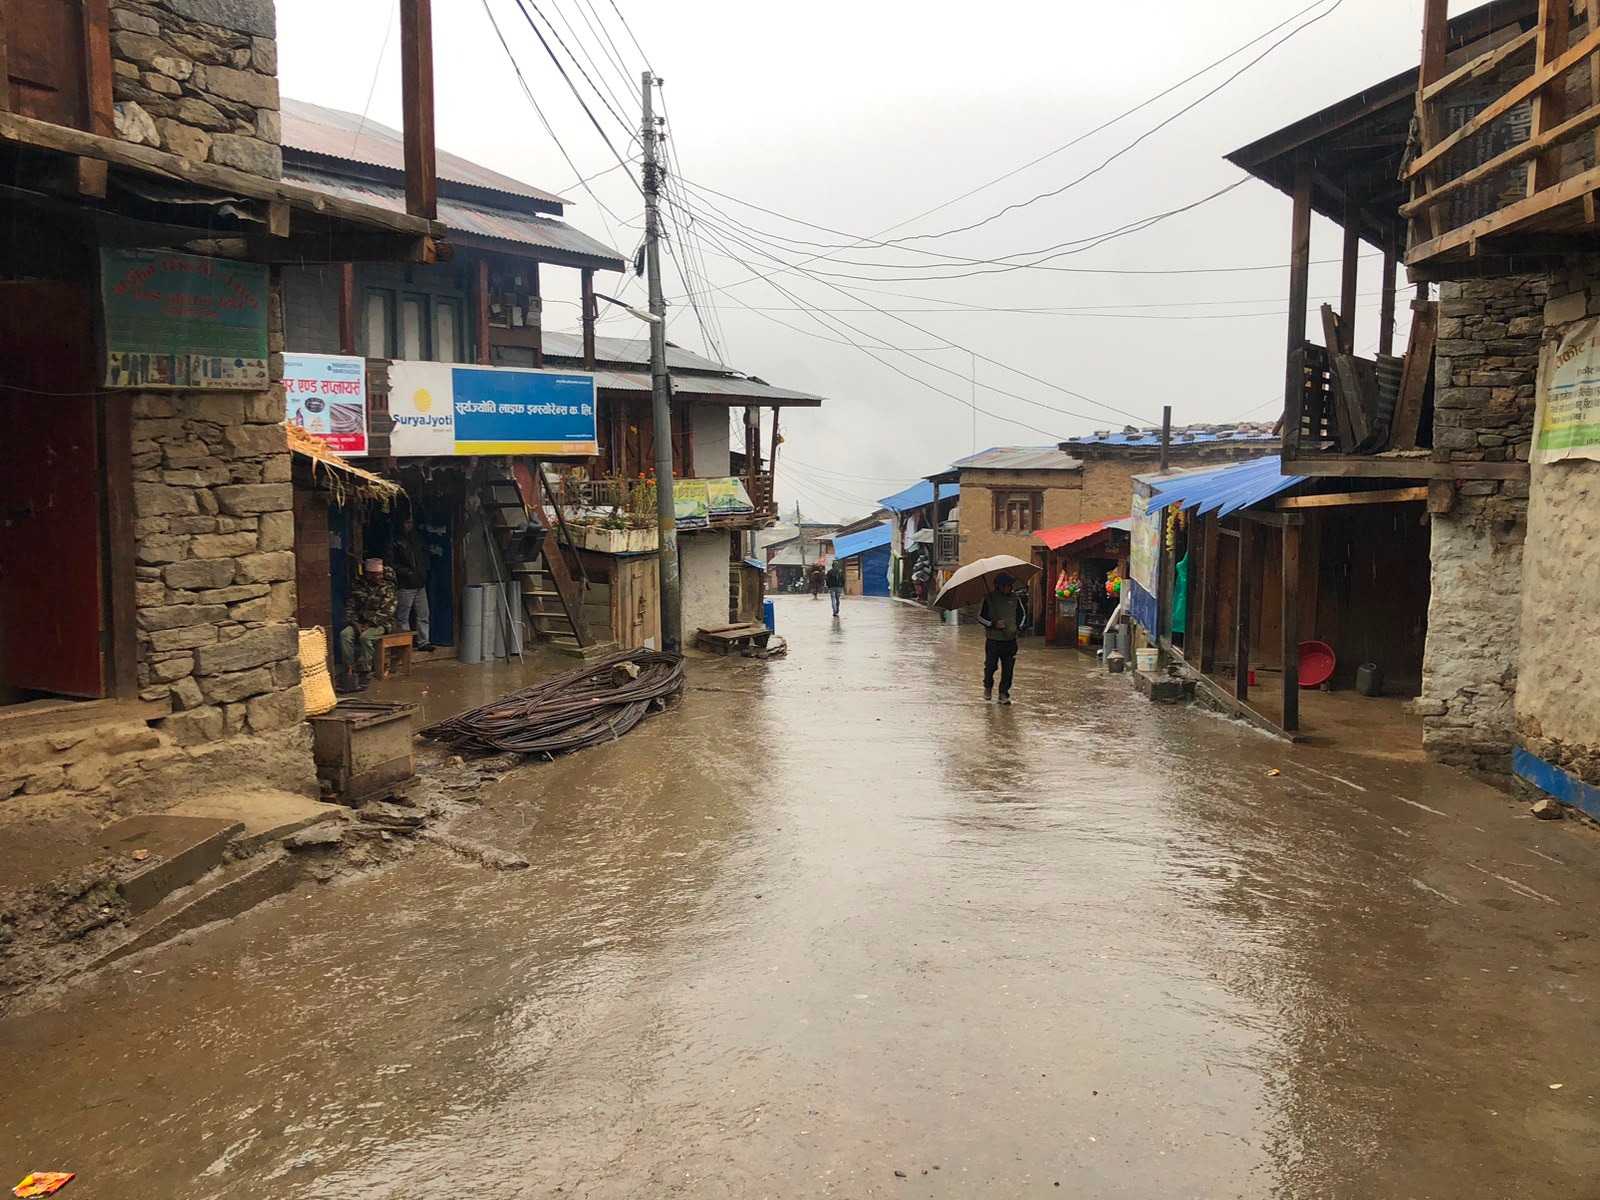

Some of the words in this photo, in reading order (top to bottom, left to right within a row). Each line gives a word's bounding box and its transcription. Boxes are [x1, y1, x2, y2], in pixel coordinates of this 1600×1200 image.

[298, 379, 318, 394] एण्ड
[321, 378, 361, 395] सप्लायर्स
[455, 400, 497, 415] सूर्यज्योति
[498, 403, 525, 415] लाइफ
[581, 403, 593, 416] लि.
[393, 414, 452, 427] SuryaJyoti
